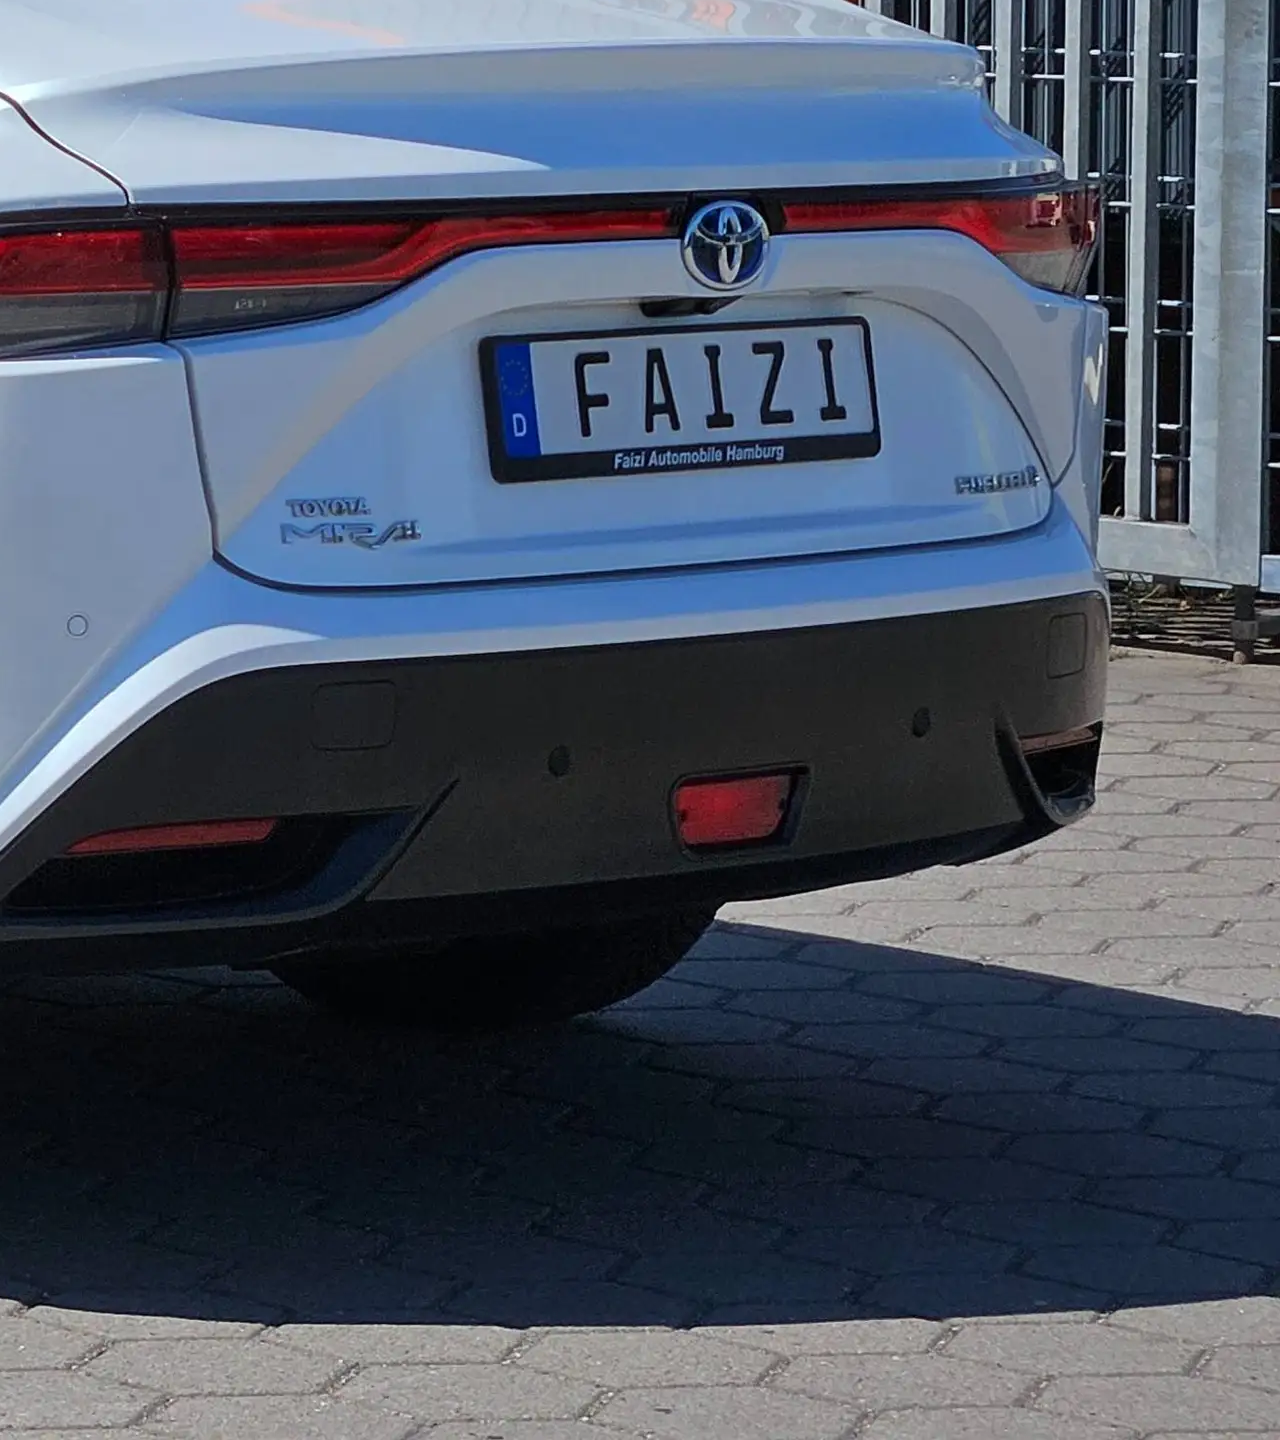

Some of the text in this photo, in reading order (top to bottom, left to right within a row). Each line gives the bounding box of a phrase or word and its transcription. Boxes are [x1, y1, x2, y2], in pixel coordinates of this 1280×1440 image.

[574, 338, 847, 438] FAIZI
[512, 413, 527, 437] D
[614, 444, 785, 469] Faizi Automobile Hamburg
[285, 496, 371, 518] TOYOTA
